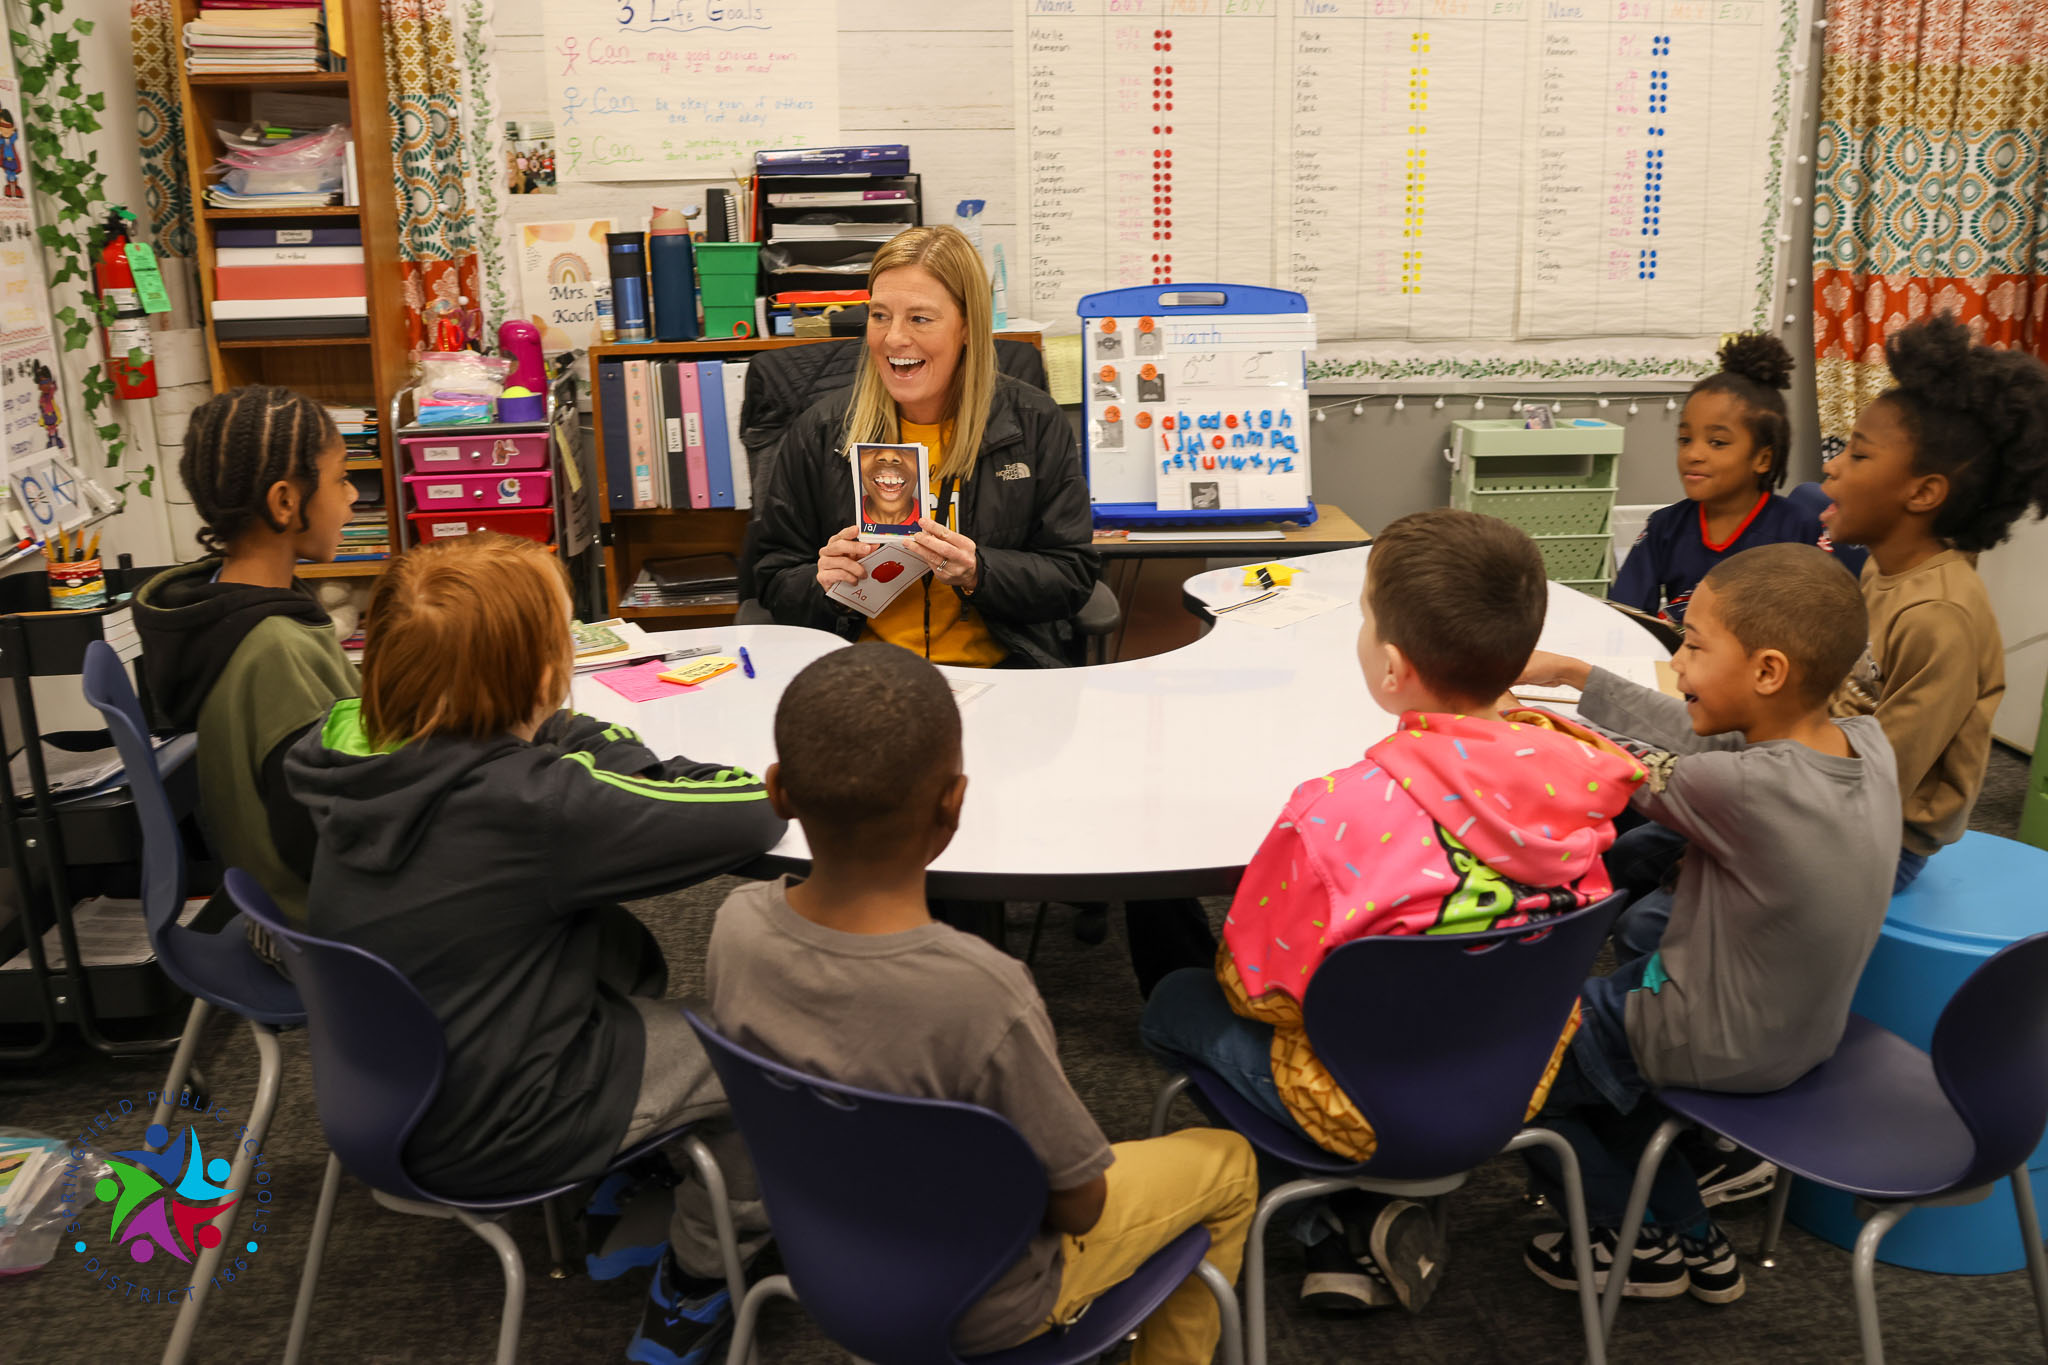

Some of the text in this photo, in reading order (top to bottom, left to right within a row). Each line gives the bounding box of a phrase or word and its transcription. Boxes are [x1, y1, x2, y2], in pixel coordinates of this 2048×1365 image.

[616, 0, 765, 26] 3 Life Goals
[1034, 0, 1077, 13] Name
[587, 37, 631, 62] Can
[592, 86, 635, 112] Can
[592, 135, 635, 160] Can
[549, 285, 589, 301] Mrs.
[553, 303, 594, 324] Koch
[1173, 323, 1224, 345] bath
[851, 588, 868, 602] Aa
